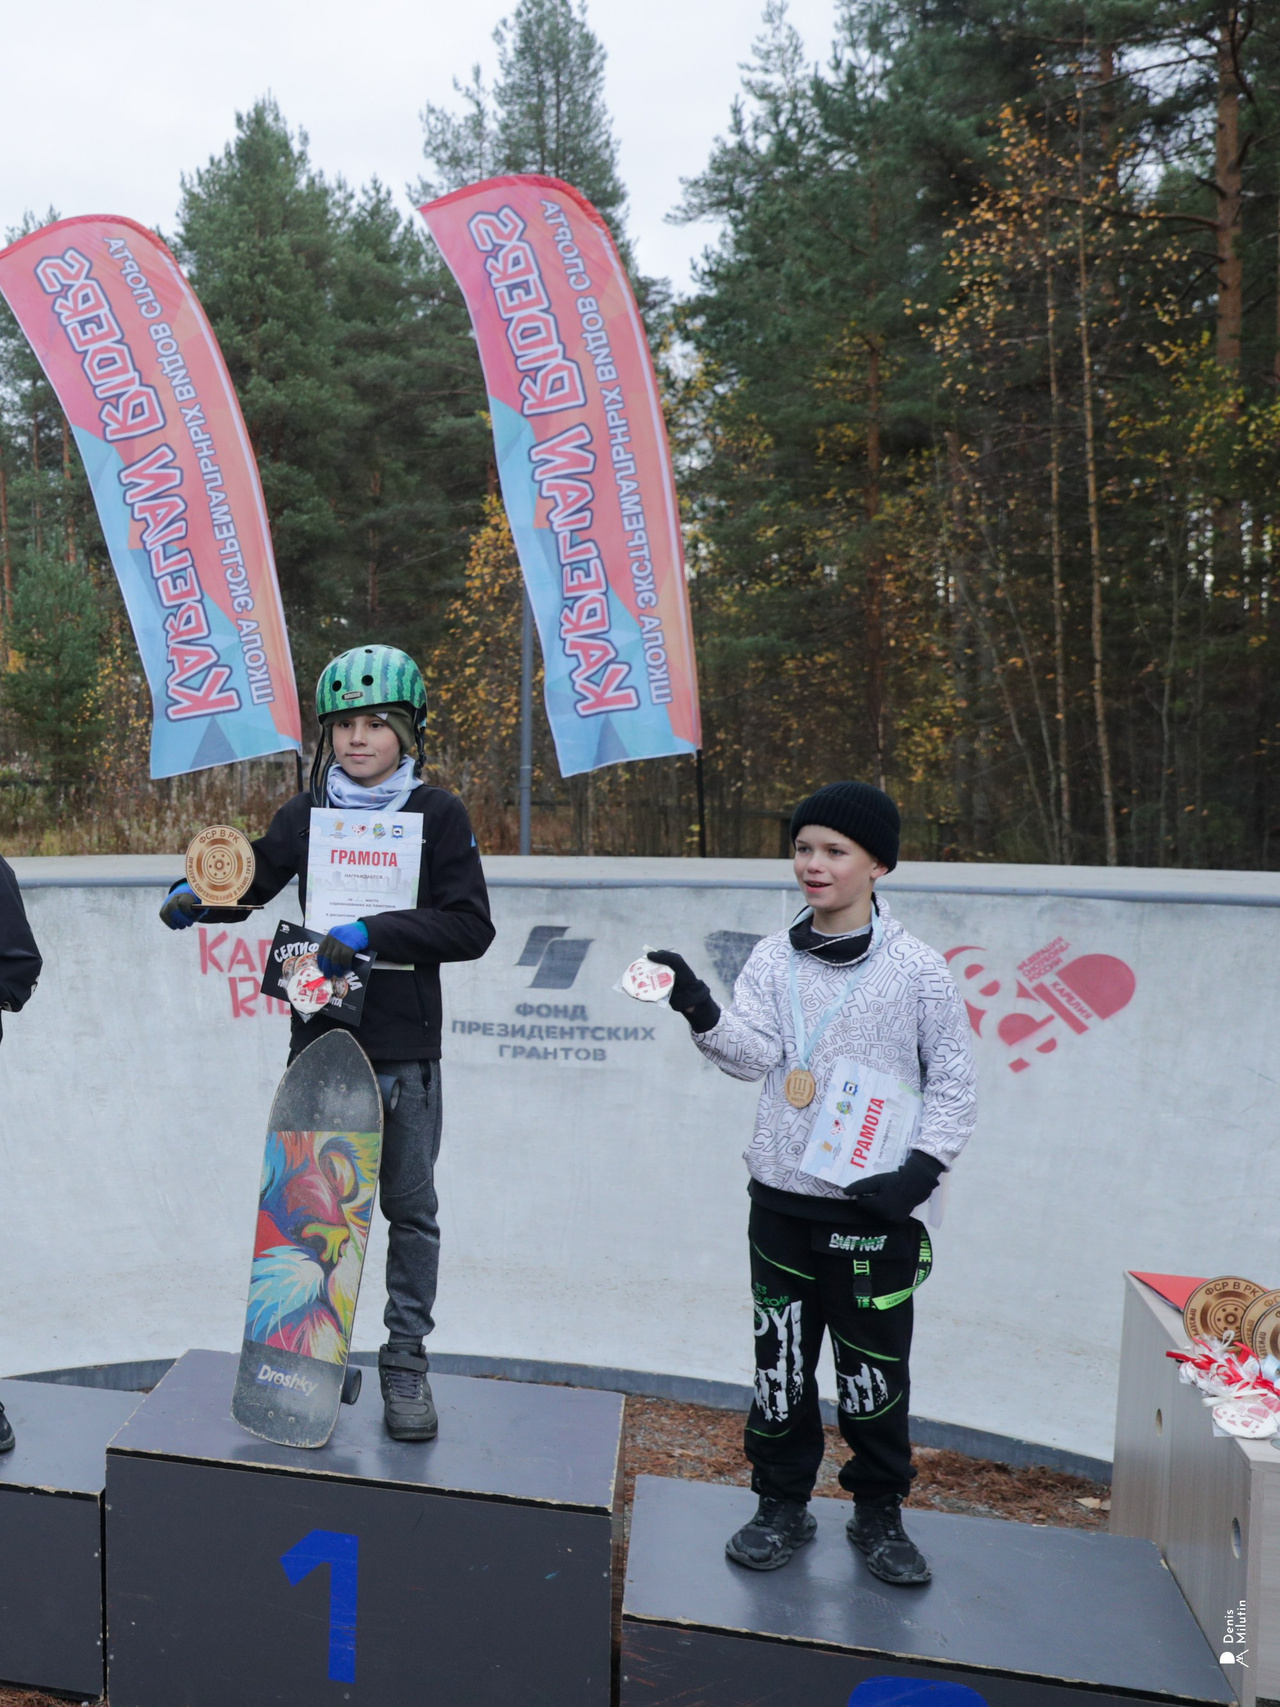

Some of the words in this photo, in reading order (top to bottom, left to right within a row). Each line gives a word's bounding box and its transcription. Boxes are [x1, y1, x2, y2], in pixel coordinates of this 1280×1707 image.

[199, 830, 217, 844] ФСР
[220, 829, 226, 838] В
[228, 831, 240, 844] РК
[330, 849, 398, 867] ГРАМОТА
[274, 941, 320, 963] СЕРТИФ
[515, 1002, 588, 1021] ФОНД
[1050, 980, 1093, 1021] КАРЕЛИЯ
[451, 1020, 656, 1042] ПРЕЗИДЕНТСКИХ
[498, 1045, 607, 1063] ГРАНТОВ
[850, 1098, 885, 1168] ГРАМОТА
[1205, 1281, 1229, 1296] ФСР
[1233, 1281, 1240, 1290] В
[1243, 1284, 1260, 1298] РК
[258, 1364, 319, 1397] Droshky
[279, 1528, 359, 1684] 1
